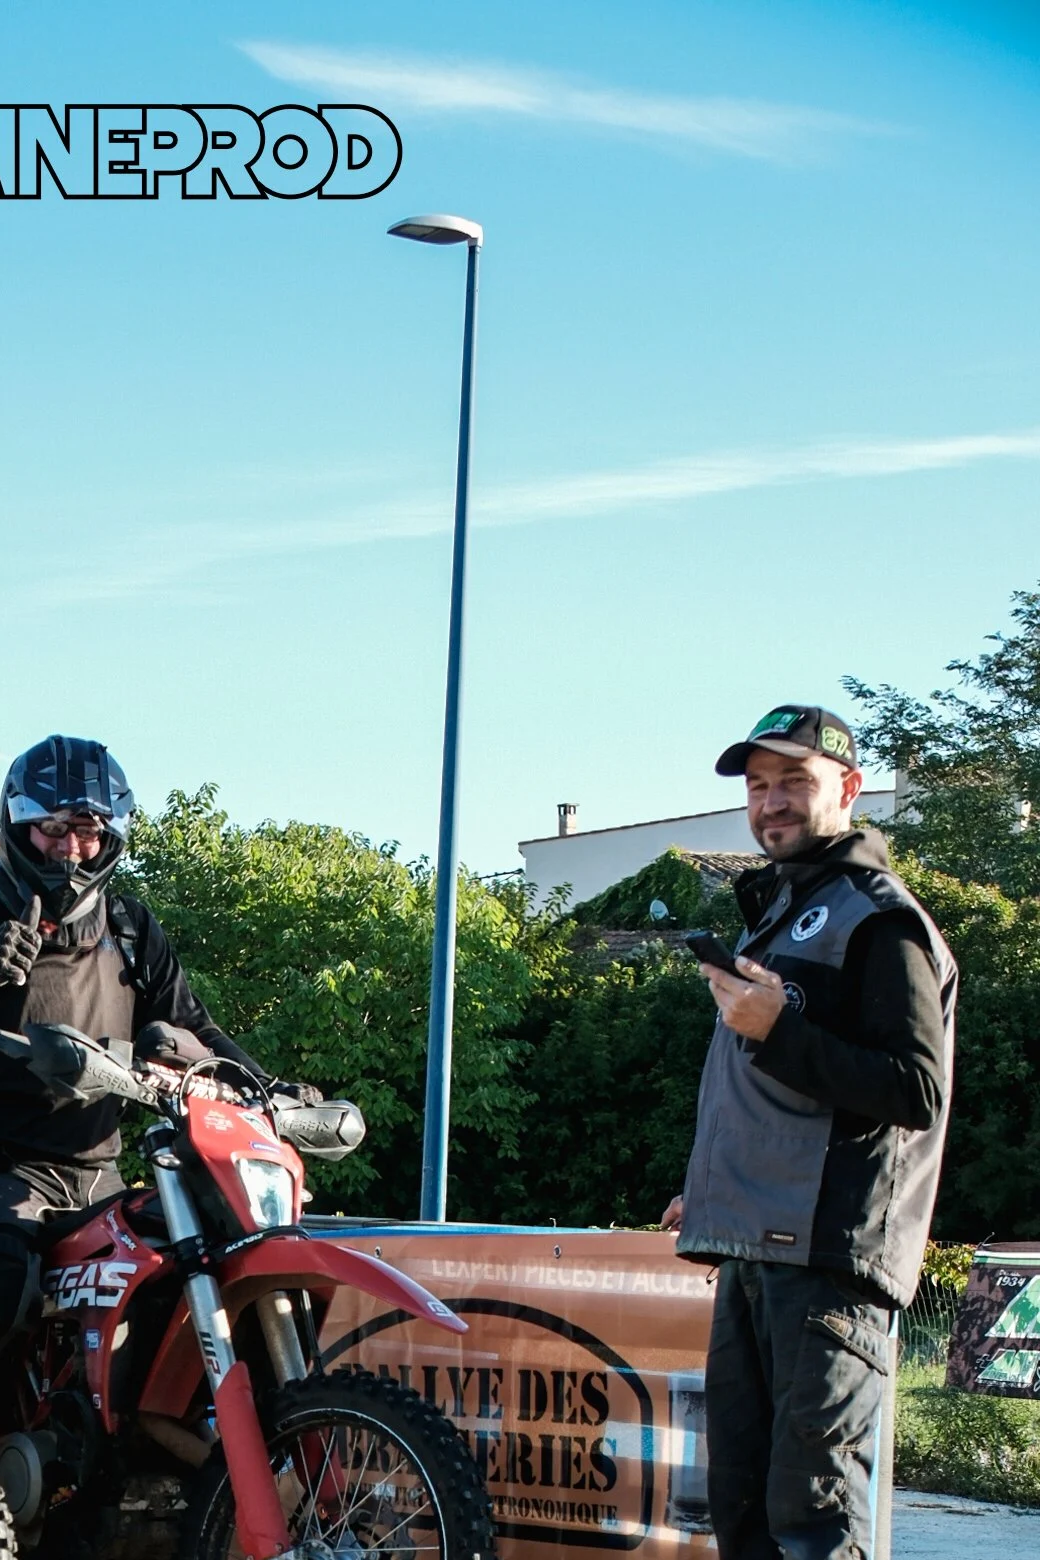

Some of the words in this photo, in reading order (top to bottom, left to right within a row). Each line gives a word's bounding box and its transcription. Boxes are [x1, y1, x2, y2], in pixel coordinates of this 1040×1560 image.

[631, 1265, 717, 1298] ACCES
[996, 1276, 1026, 1287] 1934
[517, 1369, 610, 1427] DES
